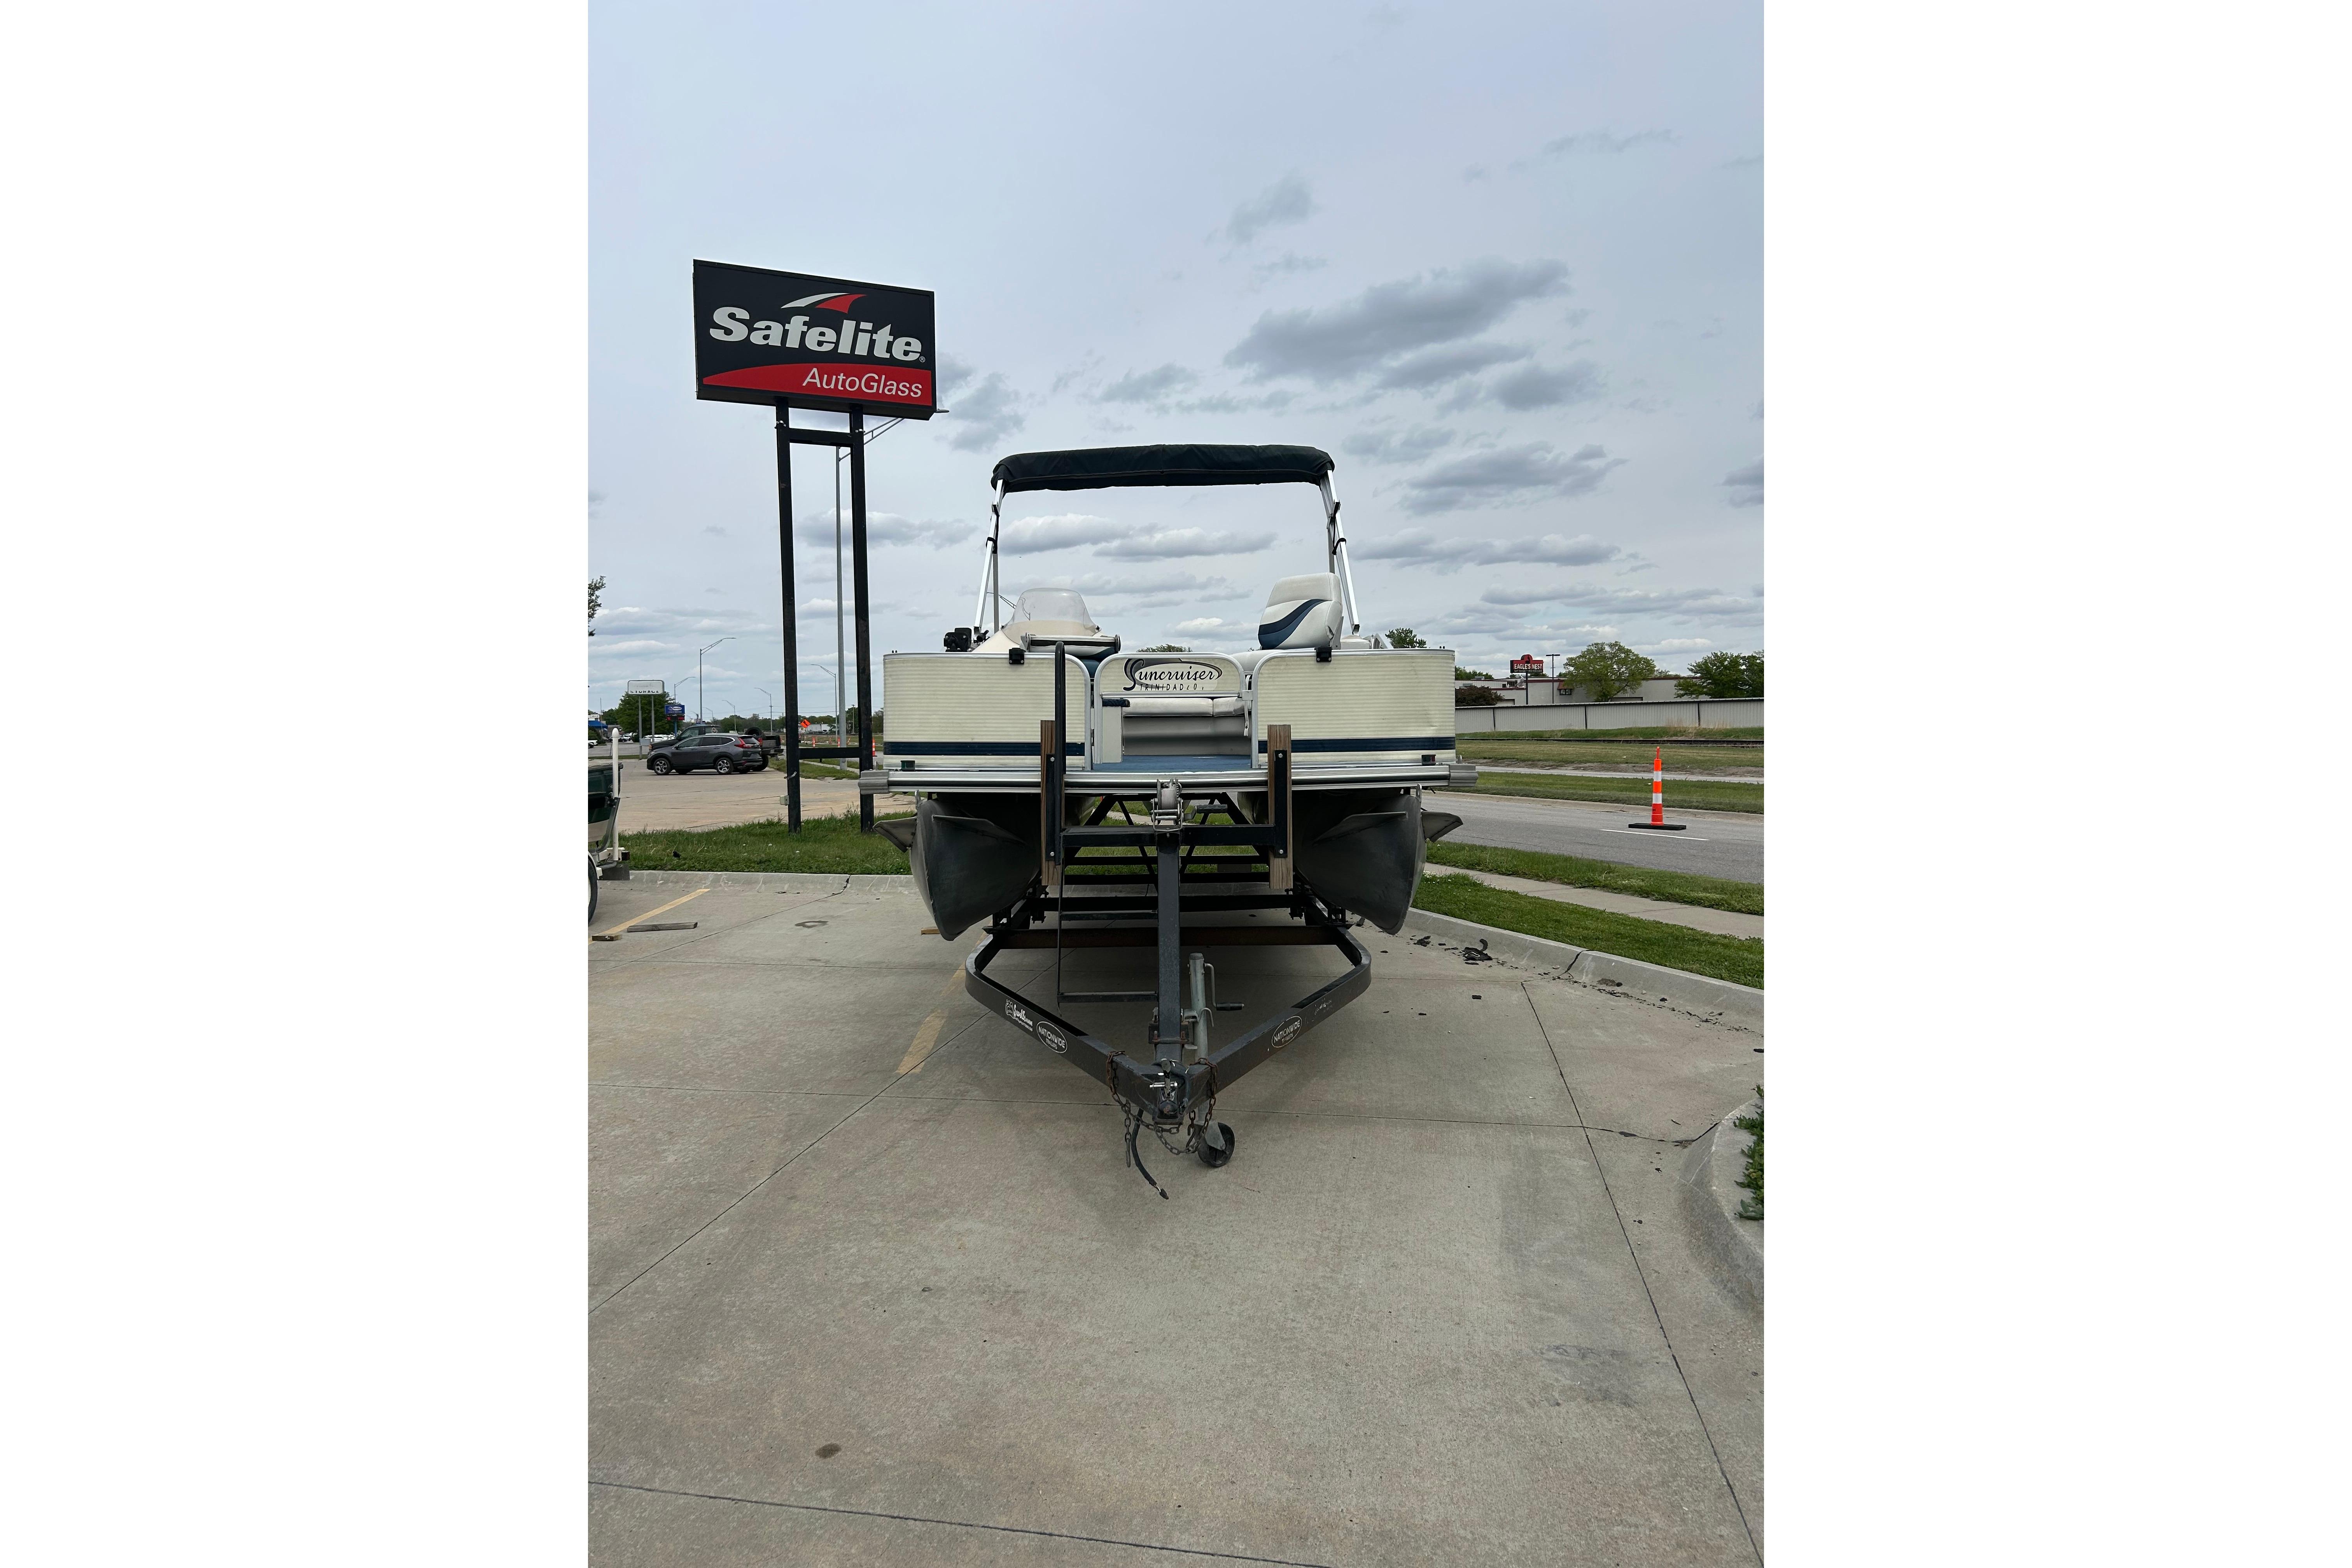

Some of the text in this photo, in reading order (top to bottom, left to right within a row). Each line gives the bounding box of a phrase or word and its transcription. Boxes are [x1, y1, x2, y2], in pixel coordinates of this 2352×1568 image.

[802, 368, 922, 397] AutoGlass
[1123, 658, 1215, 691] Suncruiser
[1038, 1026, 1065, 1048] NATIONWIDE
[1274, 1019, 1300, 1043] NATIONWIDE
